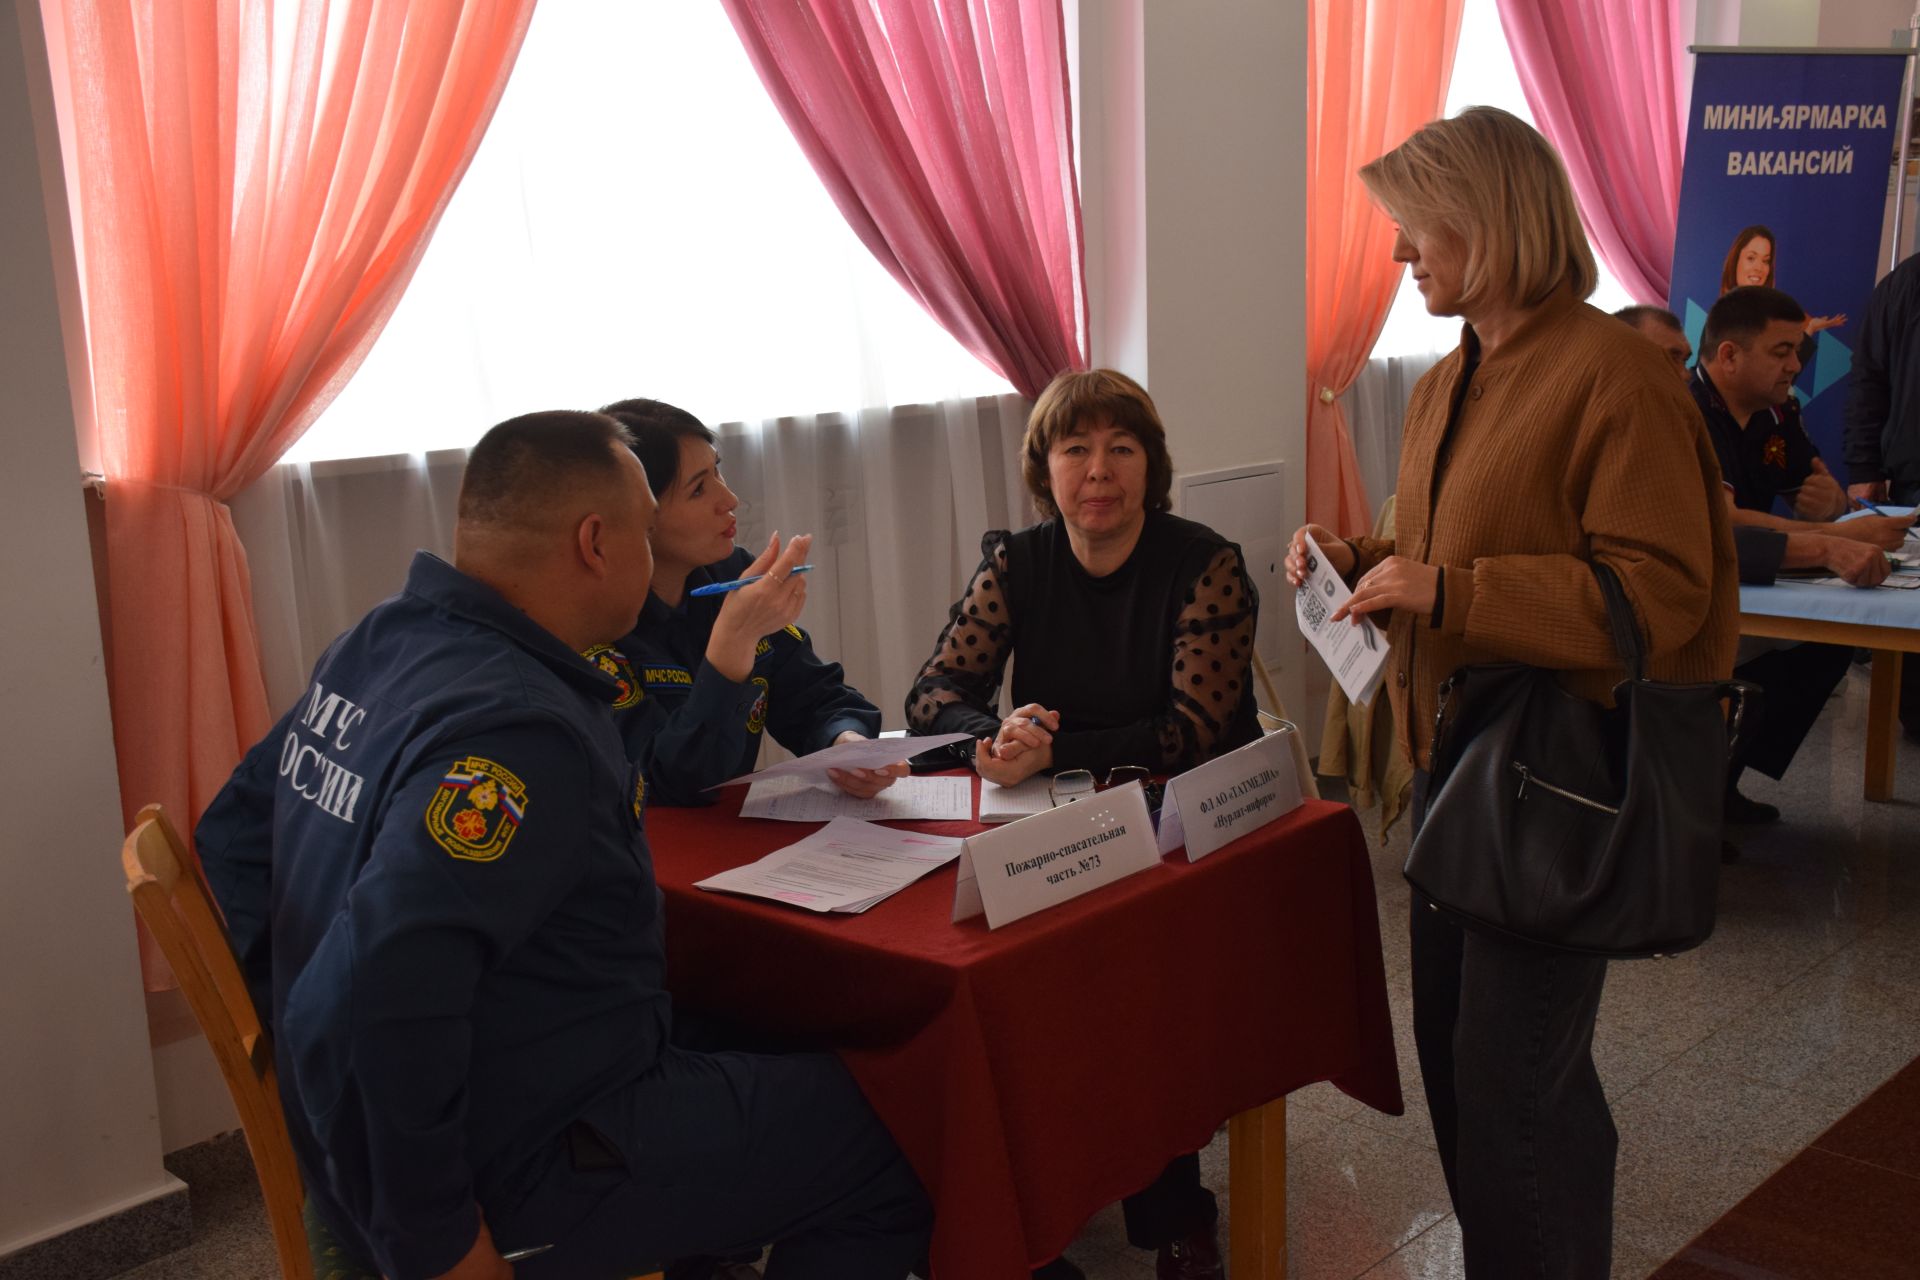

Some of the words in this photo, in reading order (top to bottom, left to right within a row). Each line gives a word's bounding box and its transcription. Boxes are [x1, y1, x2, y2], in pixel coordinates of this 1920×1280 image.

[1703, 104, 1887, 130] МИНИ-ЯРМАРКА
[1727, 145, 1854, 176] ВАКАНСИЙ
[645, 669, 667, 683] МЧС
[300, 682, 367, 751] МЧС
[279, 730, 365, 823] ОСИИ
[471, 760, 489, 771] МЧС
[491, 766, 521, 793] РОССИИ
[1216, 791, 1228, 808] АО
[1005, 823, 1127, 878] Пожарно-спасательная
[1046, 868, 1077, 887] часть
[1077, 854, 1102, 875] №73
